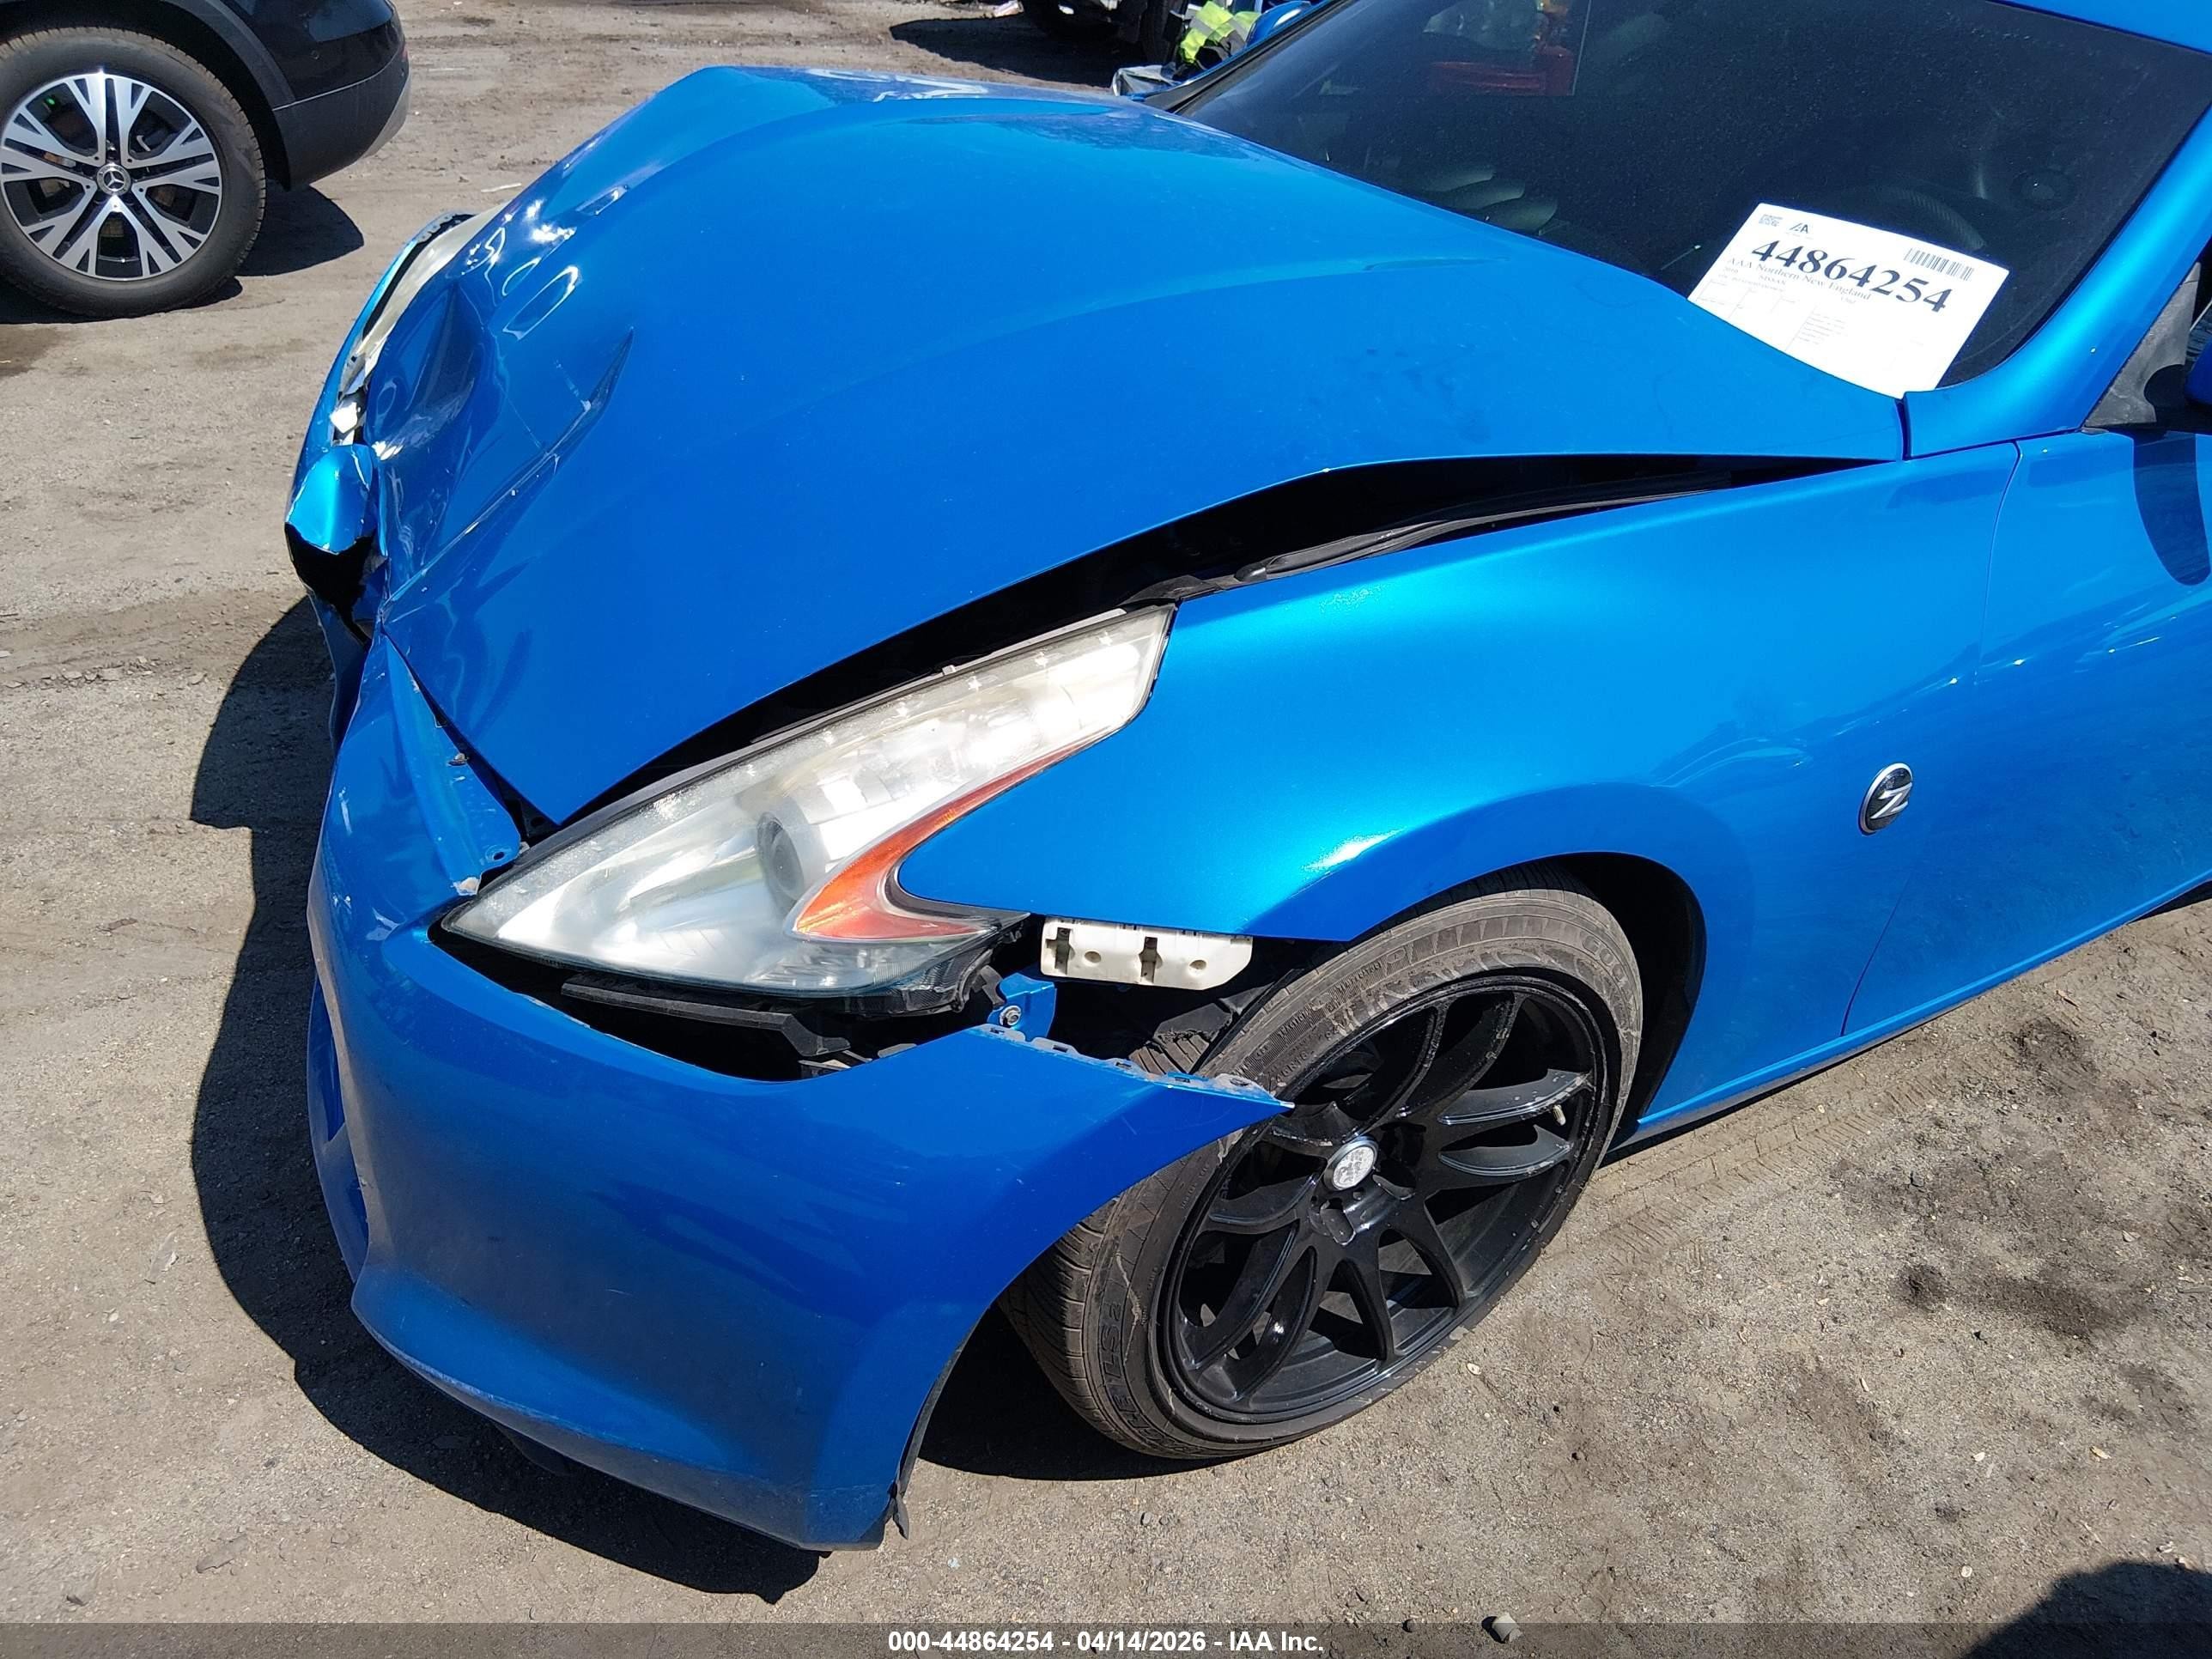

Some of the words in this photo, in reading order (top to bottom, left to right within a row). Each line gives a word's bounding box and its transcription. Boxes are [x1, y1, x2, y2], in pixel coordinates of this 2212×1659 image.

[1727, 257, 1752, 269] AAA
[1756, 264, 1800, 280] Northern
[1802, 274, 1826, 289] New
[1828, 281, 1872, 301] England
[1751, 239, 1953, 313] 44864254
